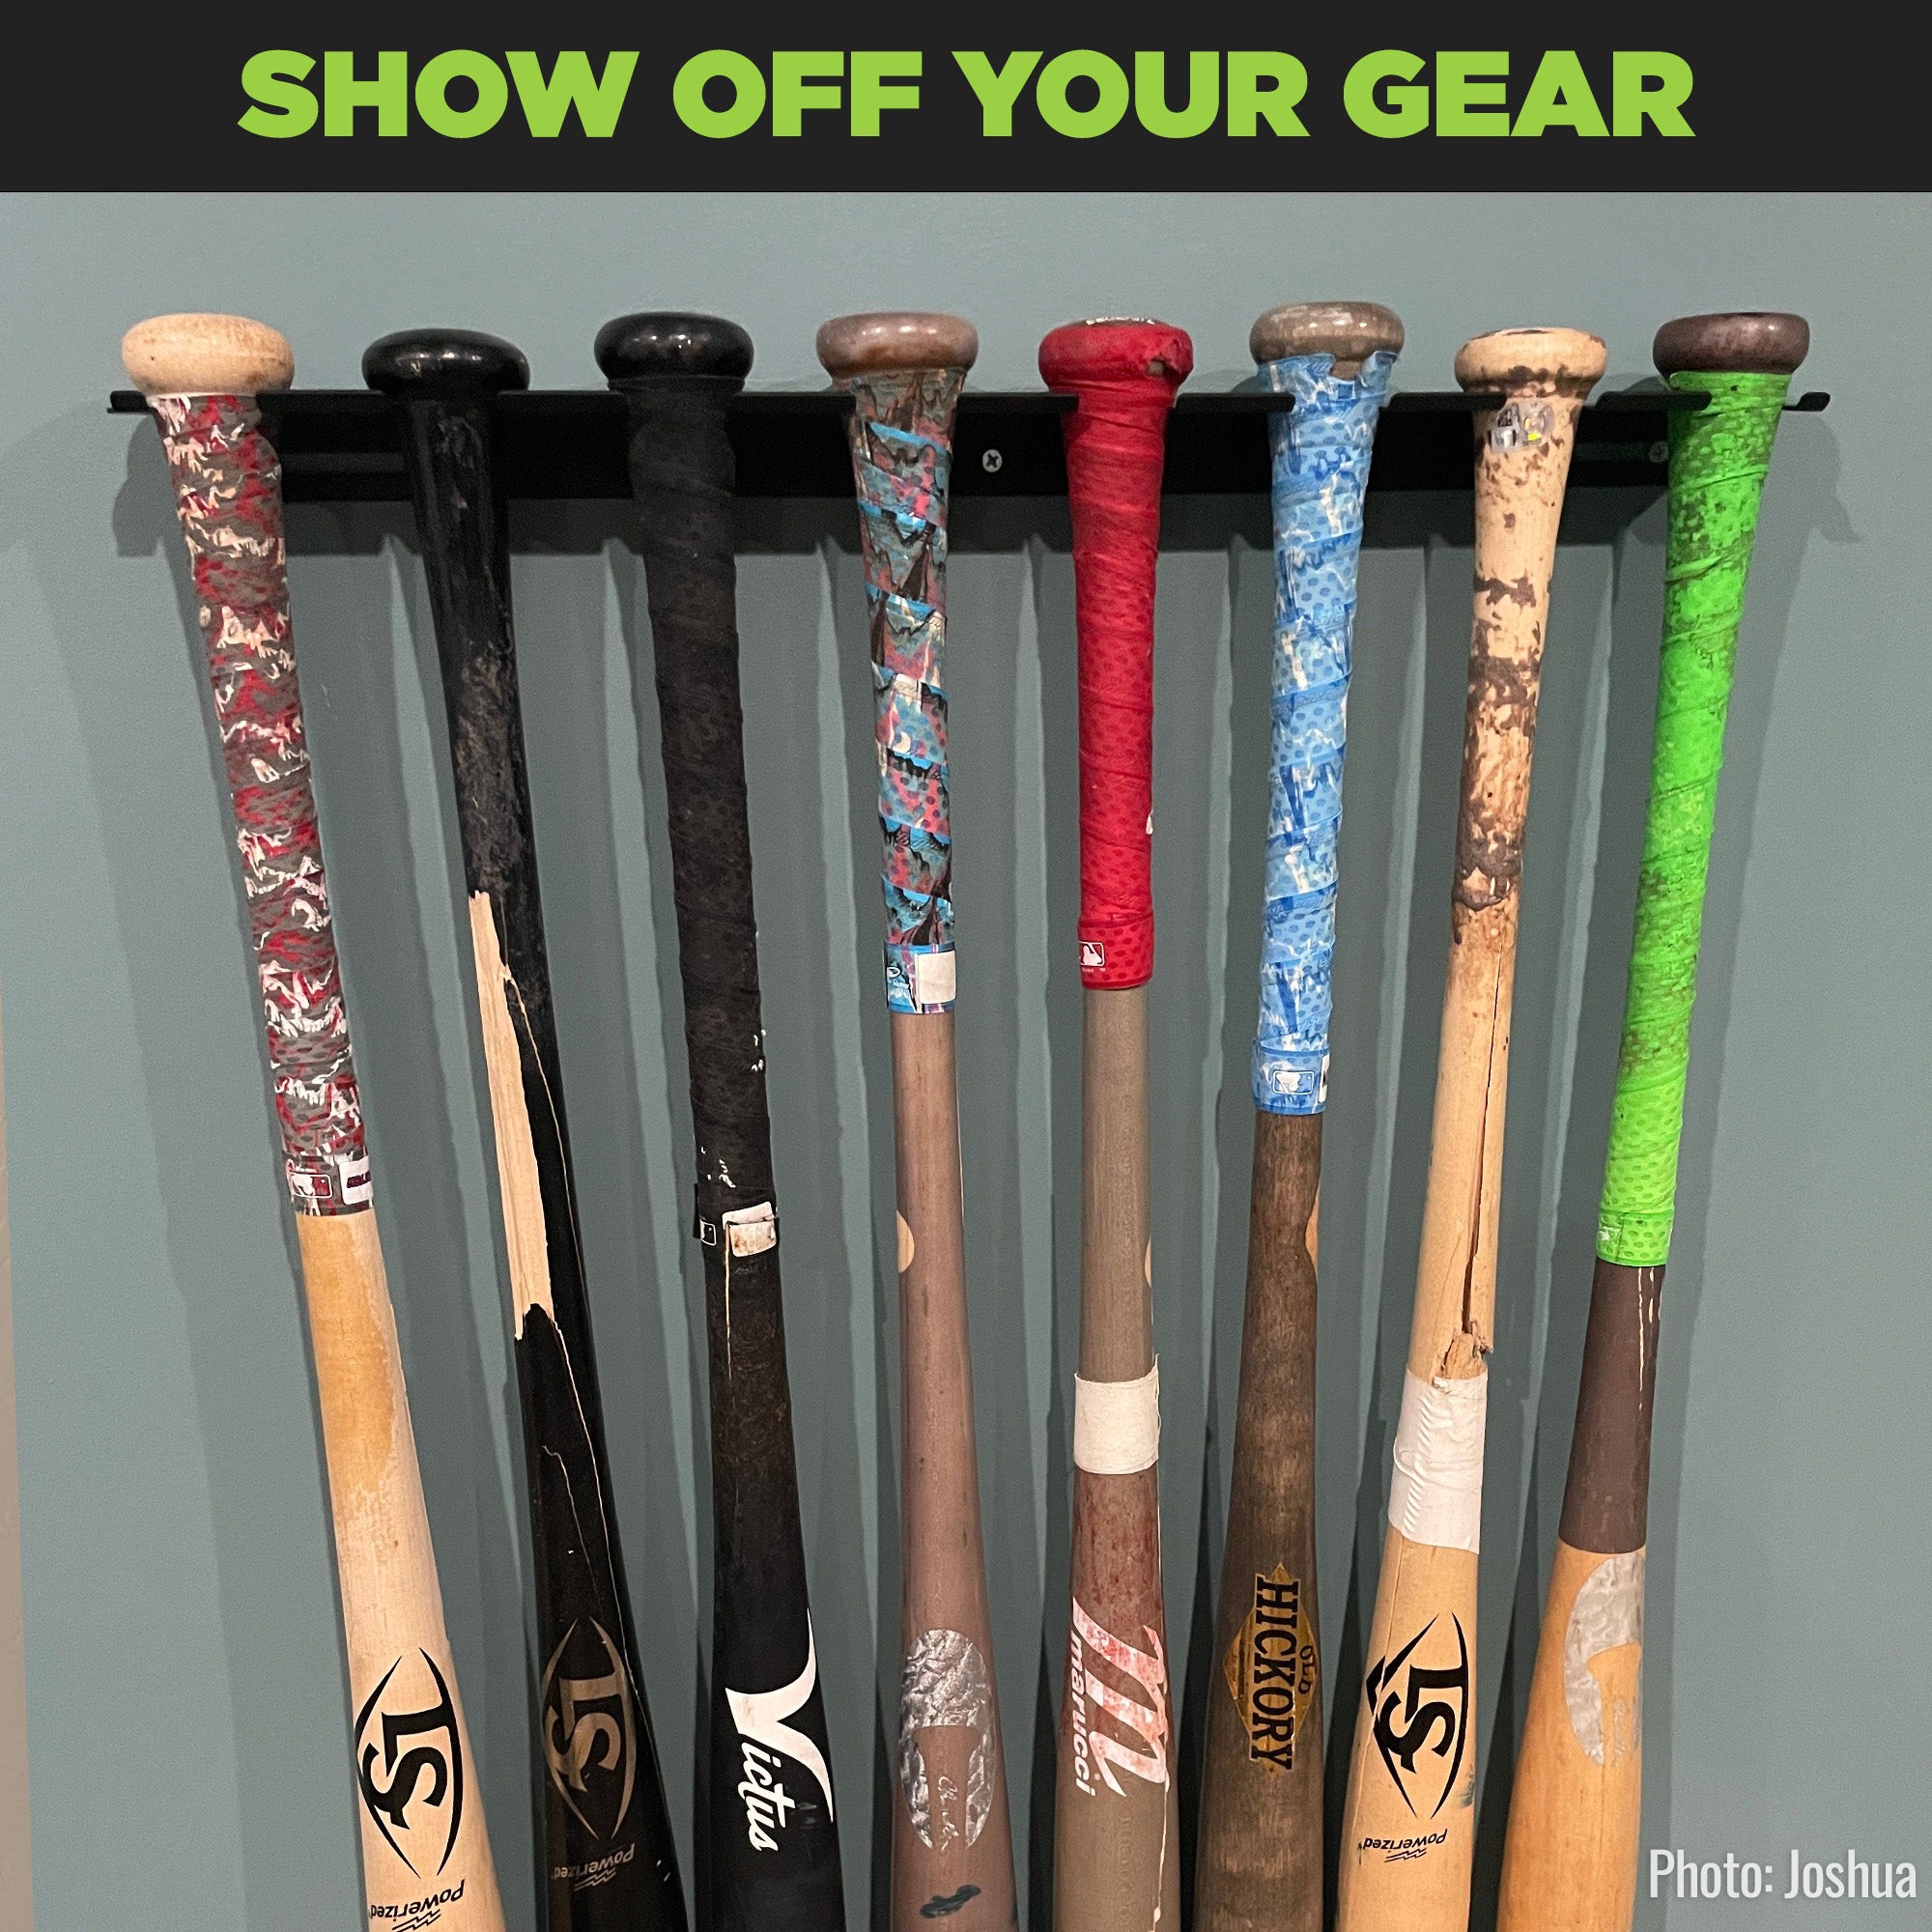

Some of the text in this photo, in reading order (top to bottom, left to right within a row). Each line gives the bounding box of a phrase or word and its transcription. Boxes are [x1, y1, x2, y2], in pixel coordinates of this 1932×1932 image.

[1250, 1576, 1300, 1771] HICKORY
[1298, 1644, 1315, 1695] OLD
[724, 1606, 835, 1853] Victus
[1071, 1630, 1096, 1797] marucci
[554, 1843, 636, 1880] Powerized
[1363, 1829, 1448, 1853] Powerized
[369, 1879, 466, 1921] Powerized
